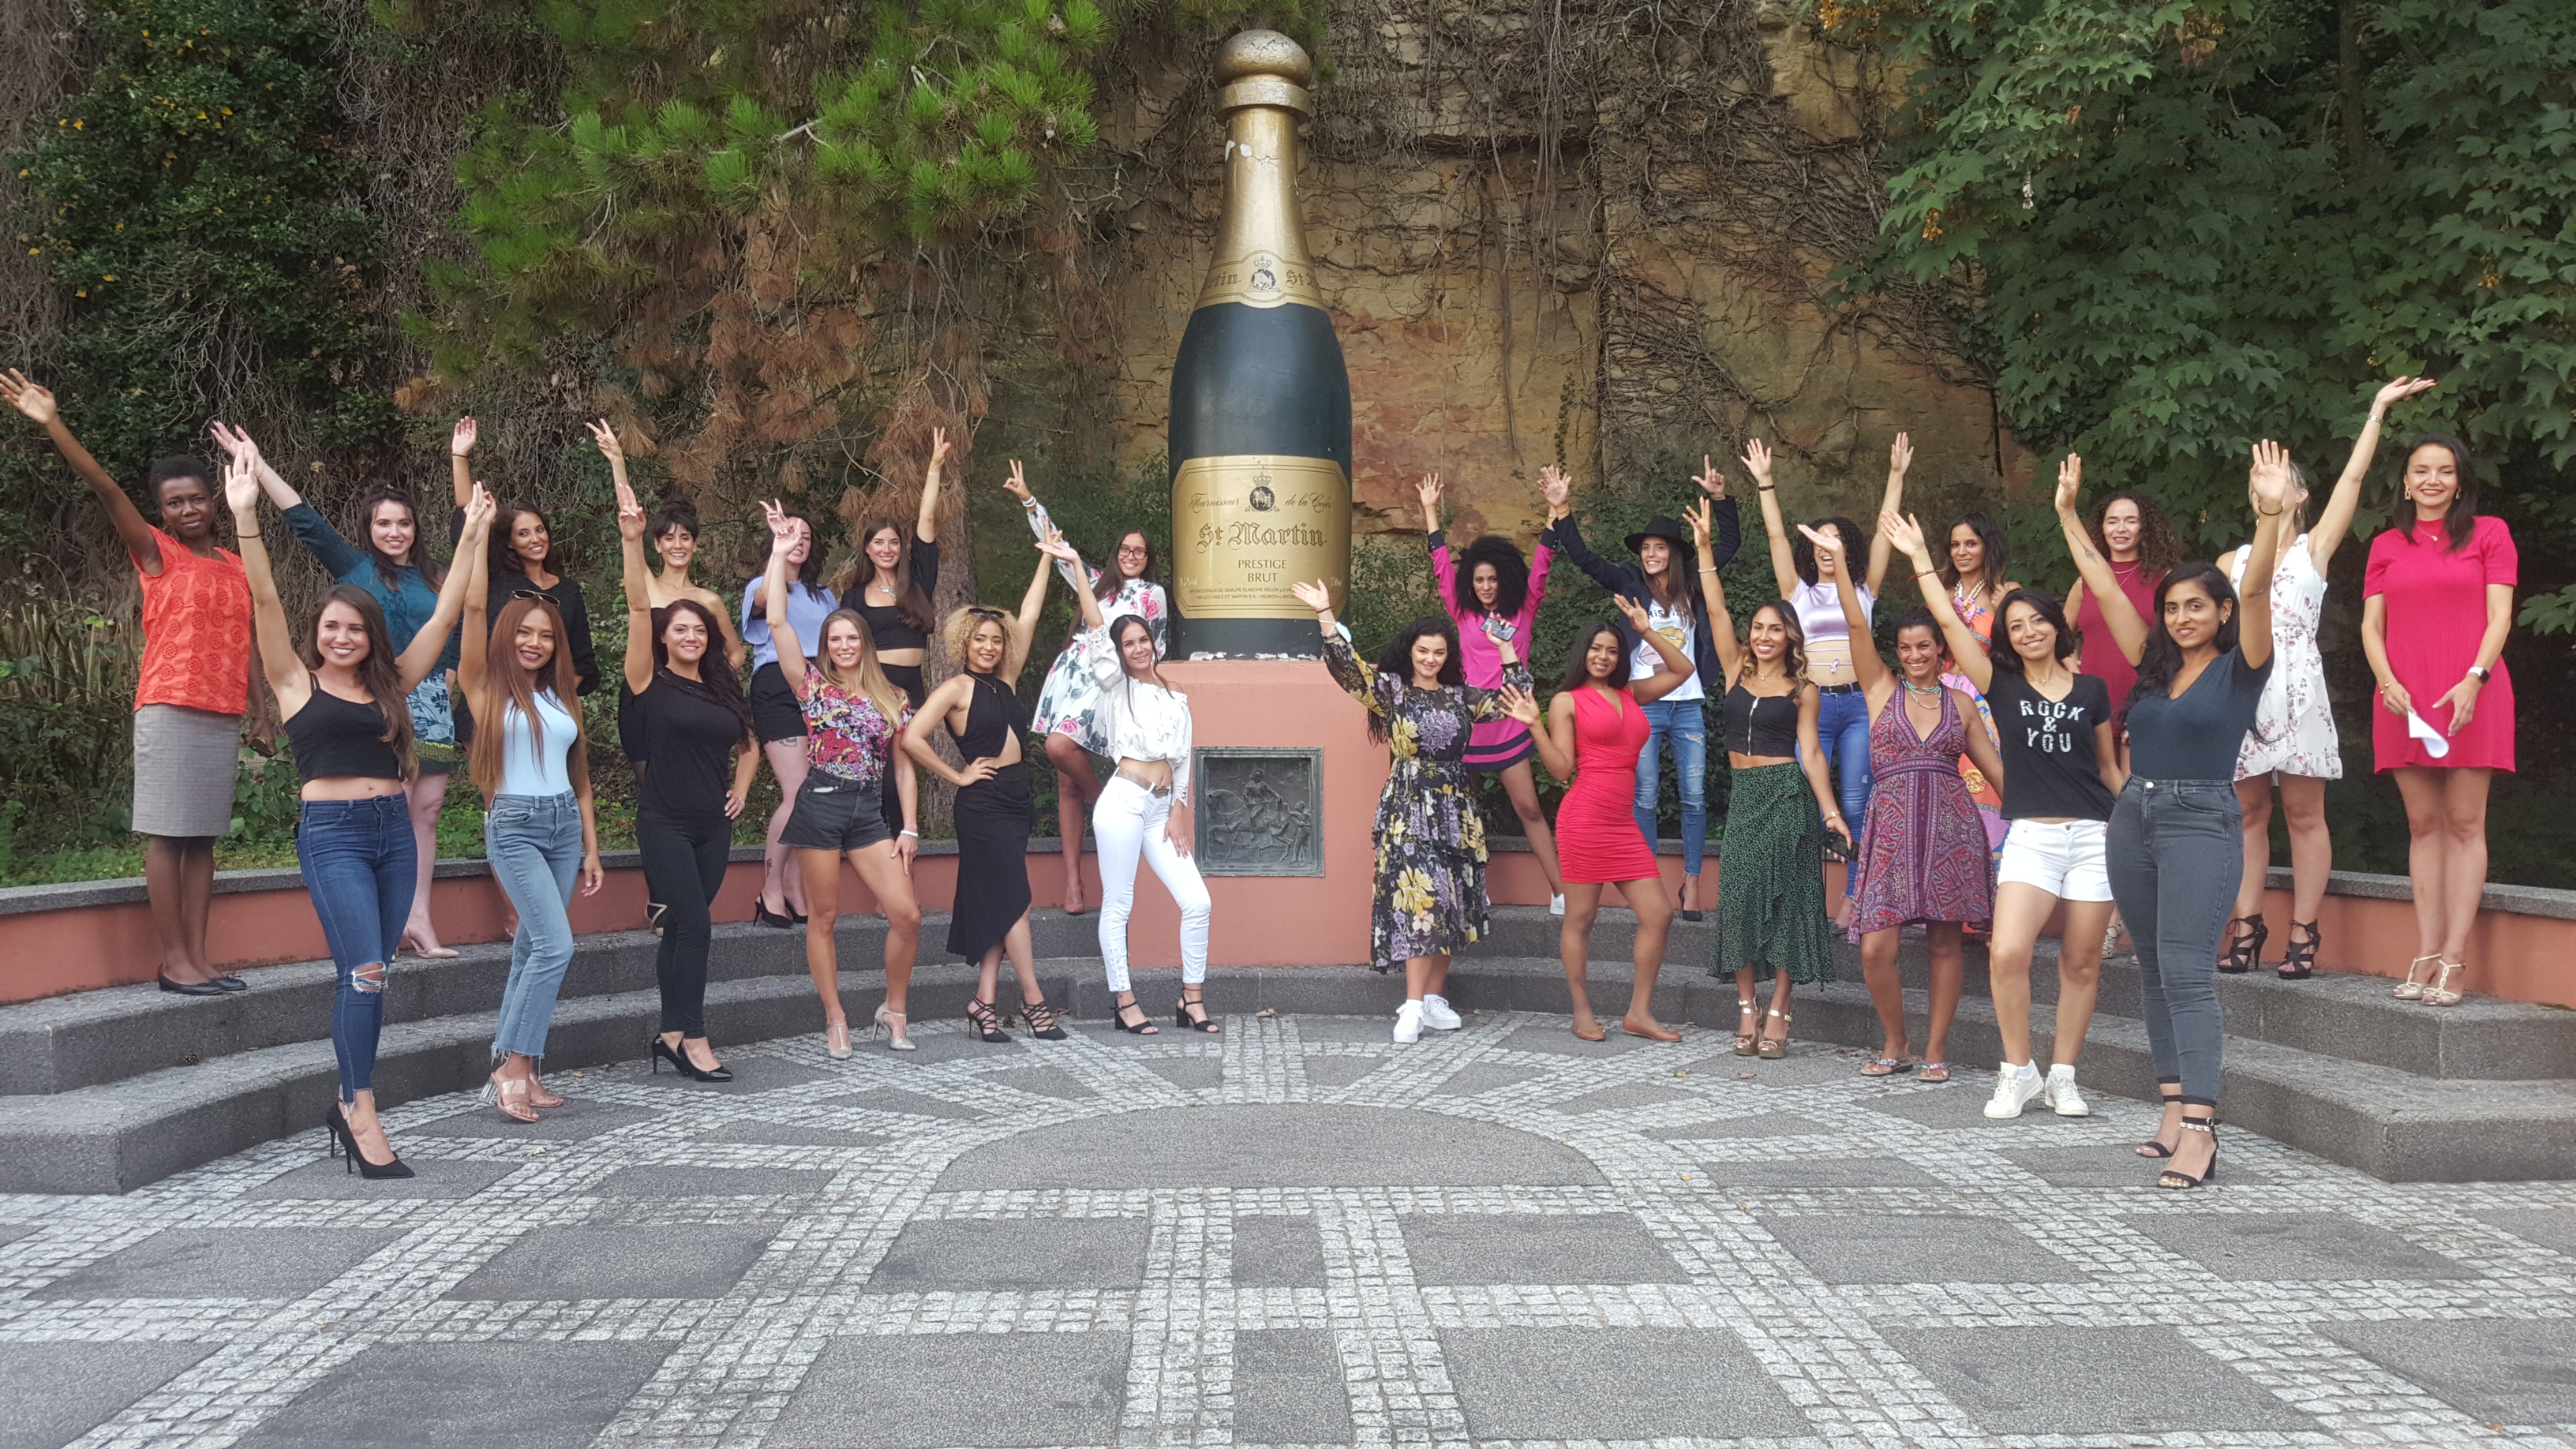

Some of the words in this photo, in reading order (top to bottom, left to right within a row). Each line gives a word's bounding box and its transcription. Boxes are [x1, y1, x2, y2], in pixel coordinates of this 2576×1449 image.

[1189, 492, 1240, 514] Fournisseur
[1285, 494, 1297, 506] de
[1298, 493, 1309, 506] la
[1309, 492, 1334, 514] Cour
[1228, 521, 1327, 551] Martin
[1238, 560, 1287, 569] PRESTIGE
[1248, 572, 1278, 582] BRUT
[2020, 699, 2085, 722] ROCK
[2043, 717, 2057, 732] &
[2027, 728, 2072, 753] YOU
